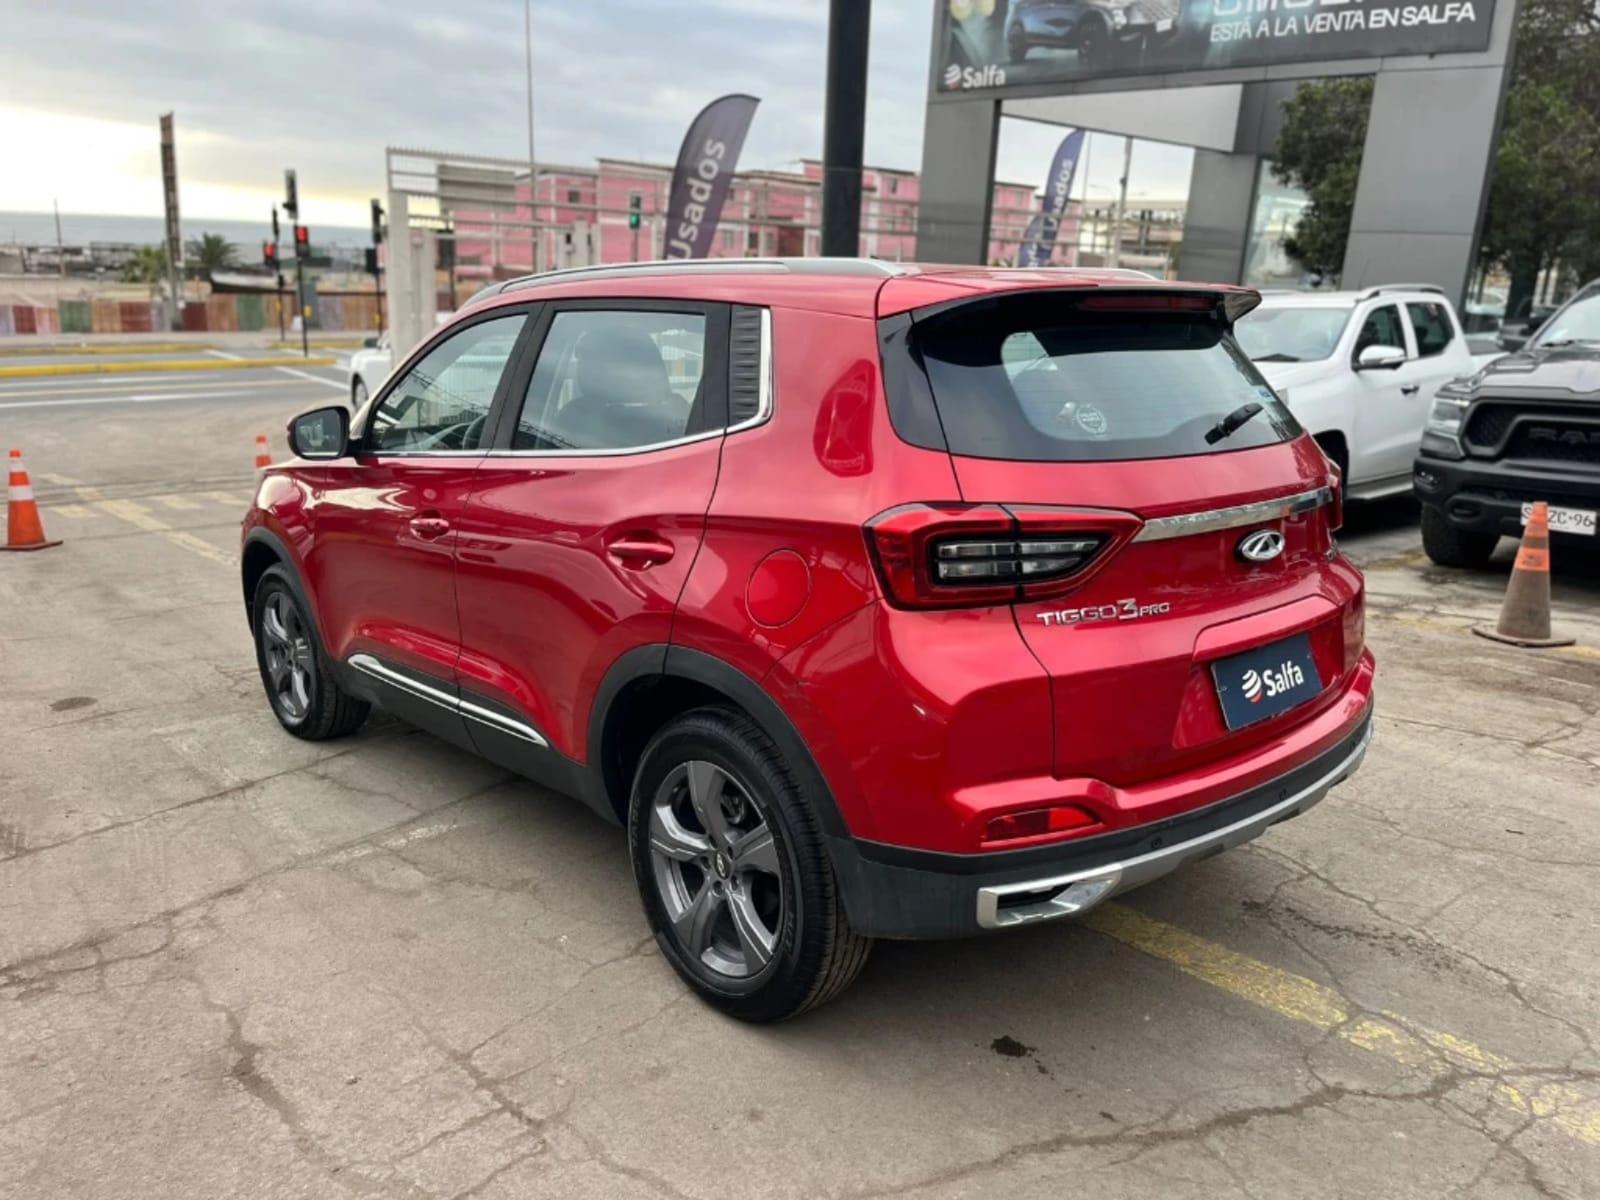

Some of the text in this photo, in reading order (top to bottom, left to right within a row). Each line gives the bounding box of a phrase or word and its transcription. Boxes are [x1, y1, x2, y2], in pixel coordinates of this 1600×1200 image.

[1255, 18, 1270, 38] A
[1274, 16, 1298, 37] LA
[1304, 10, 1365, 34] VENTA
[1368, 7, 1399, 29] EN
[1401, 2, 1476, 26] SALFA
[962, 64, 1006, 88] Salfa
[667, 138, 726, 261] Usados
[1262, 660, 1305, 697] Salfa
